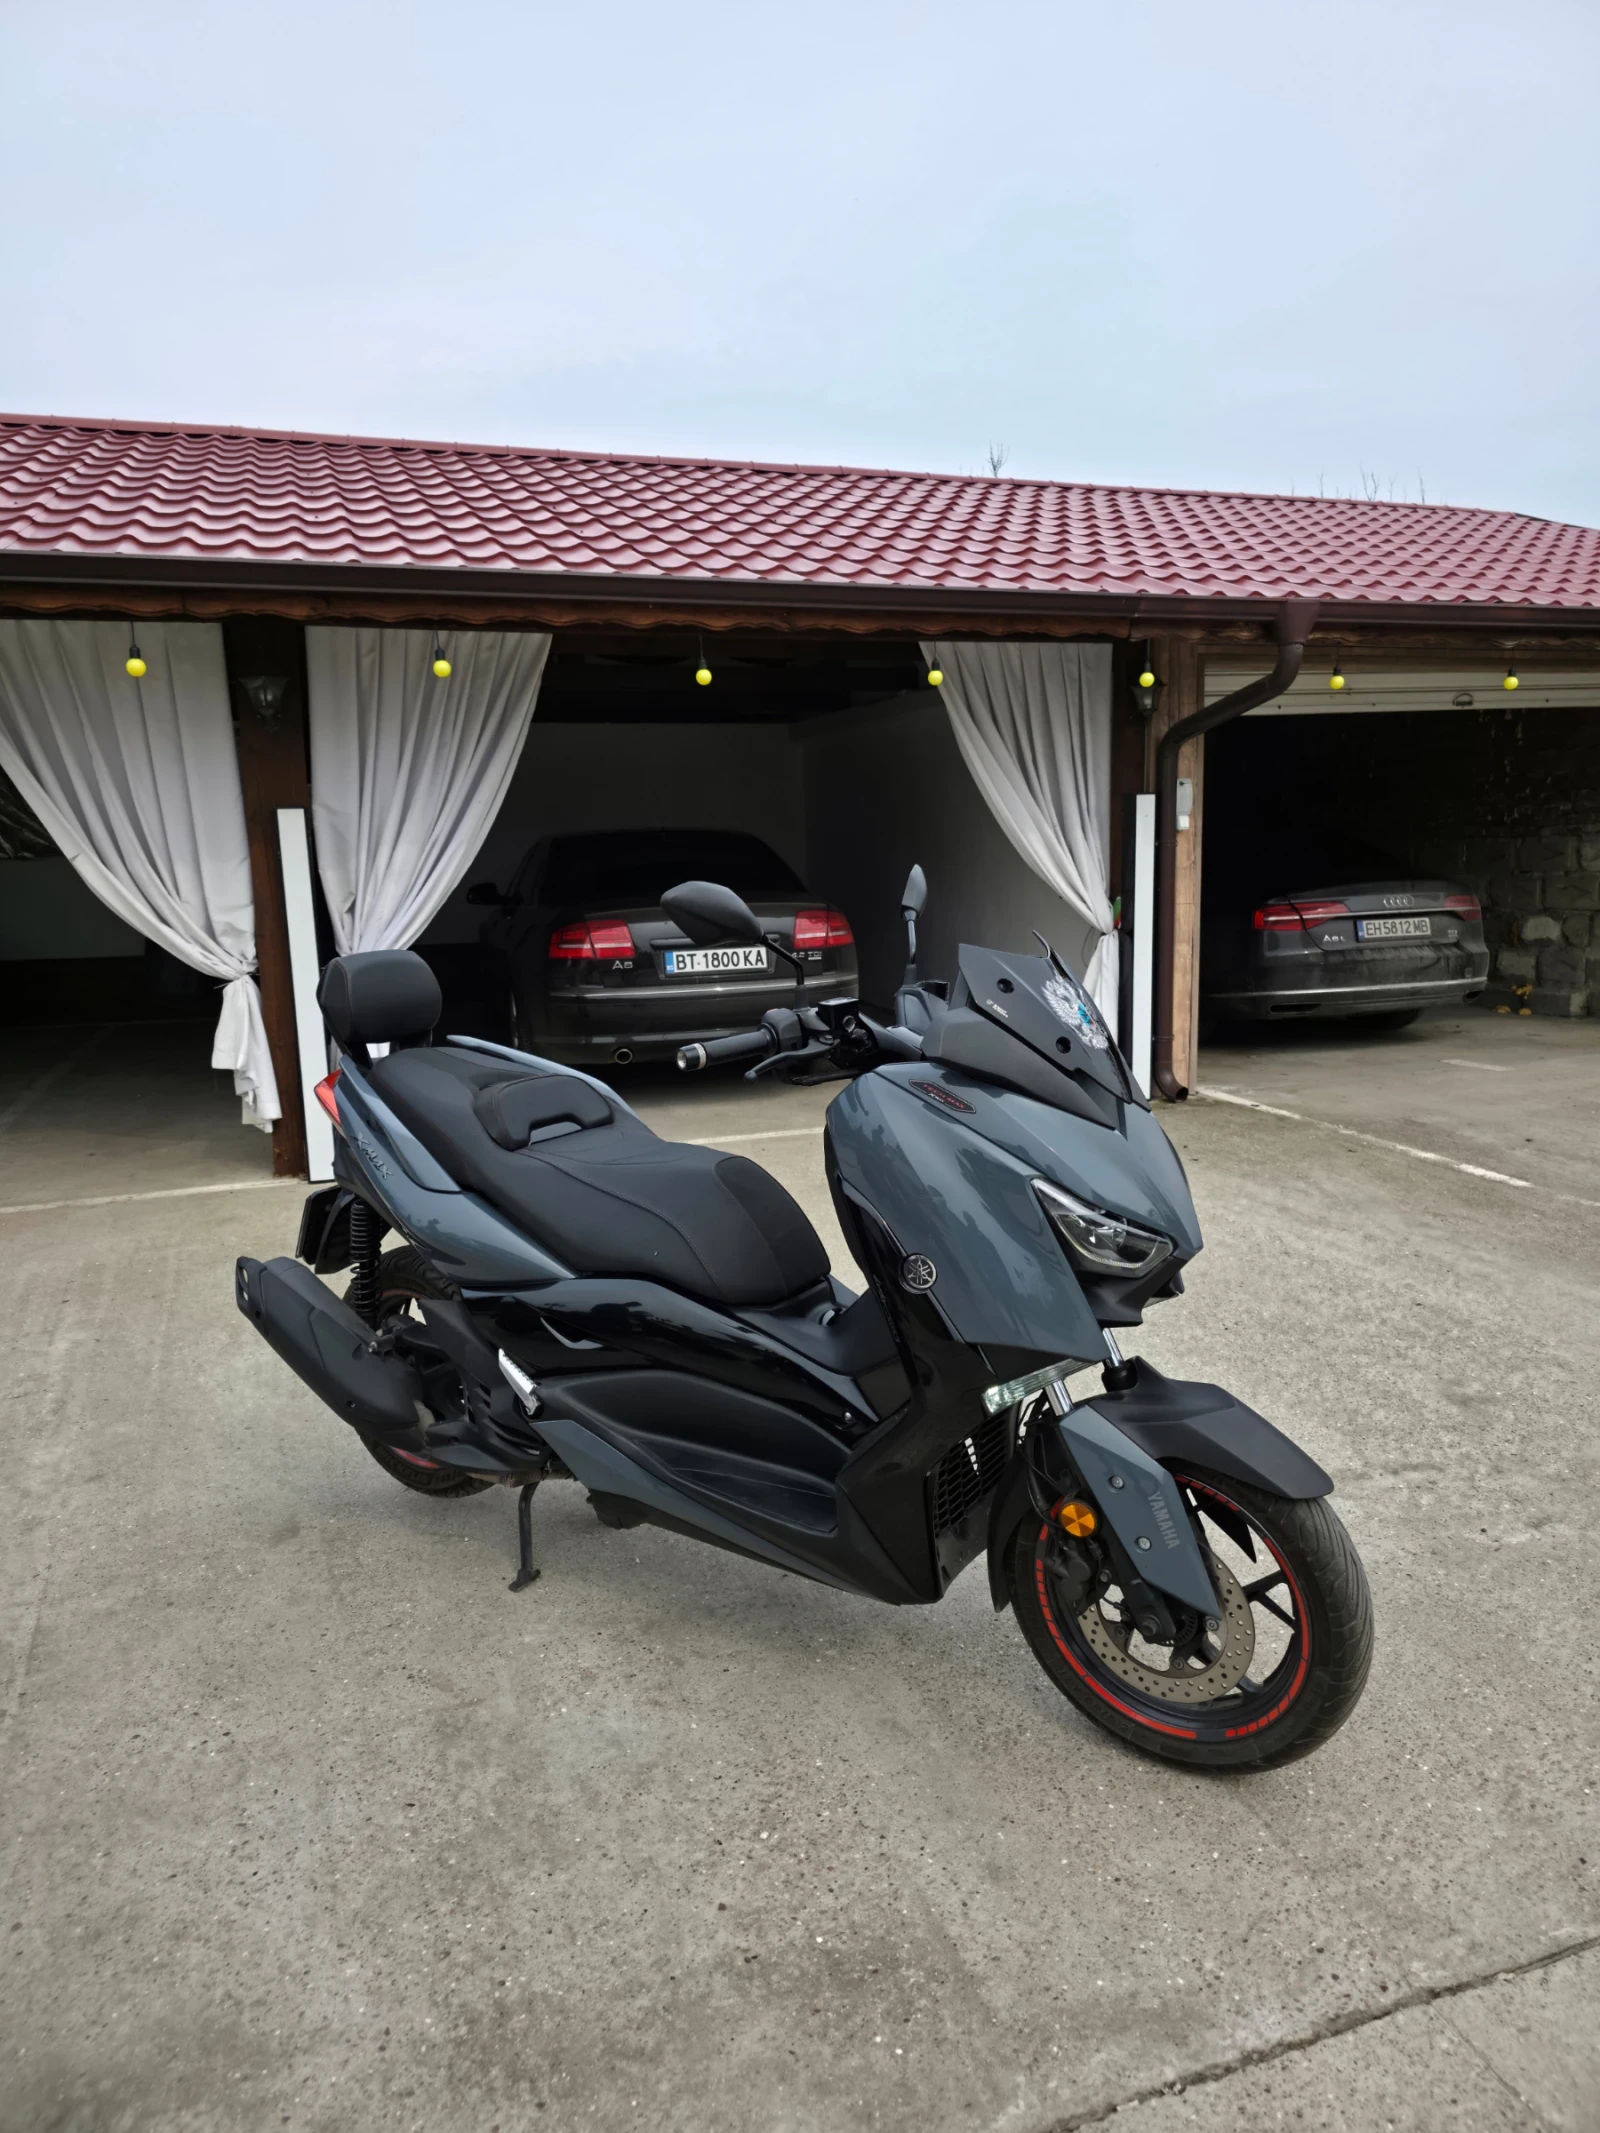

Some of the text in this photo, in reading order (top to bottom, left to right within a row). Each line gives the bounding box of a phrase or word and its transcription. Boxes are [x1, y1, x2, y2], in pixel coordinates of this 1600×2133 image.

[1365, 922, 1381, 936] EH
[1383, 920, 1412, 934] 5812
[1413, 919, 1429, 933] MB
[675, 949, 765, 970] BT 1800 KA
[1148, 1490, 1181, 1550] YAMAHA
